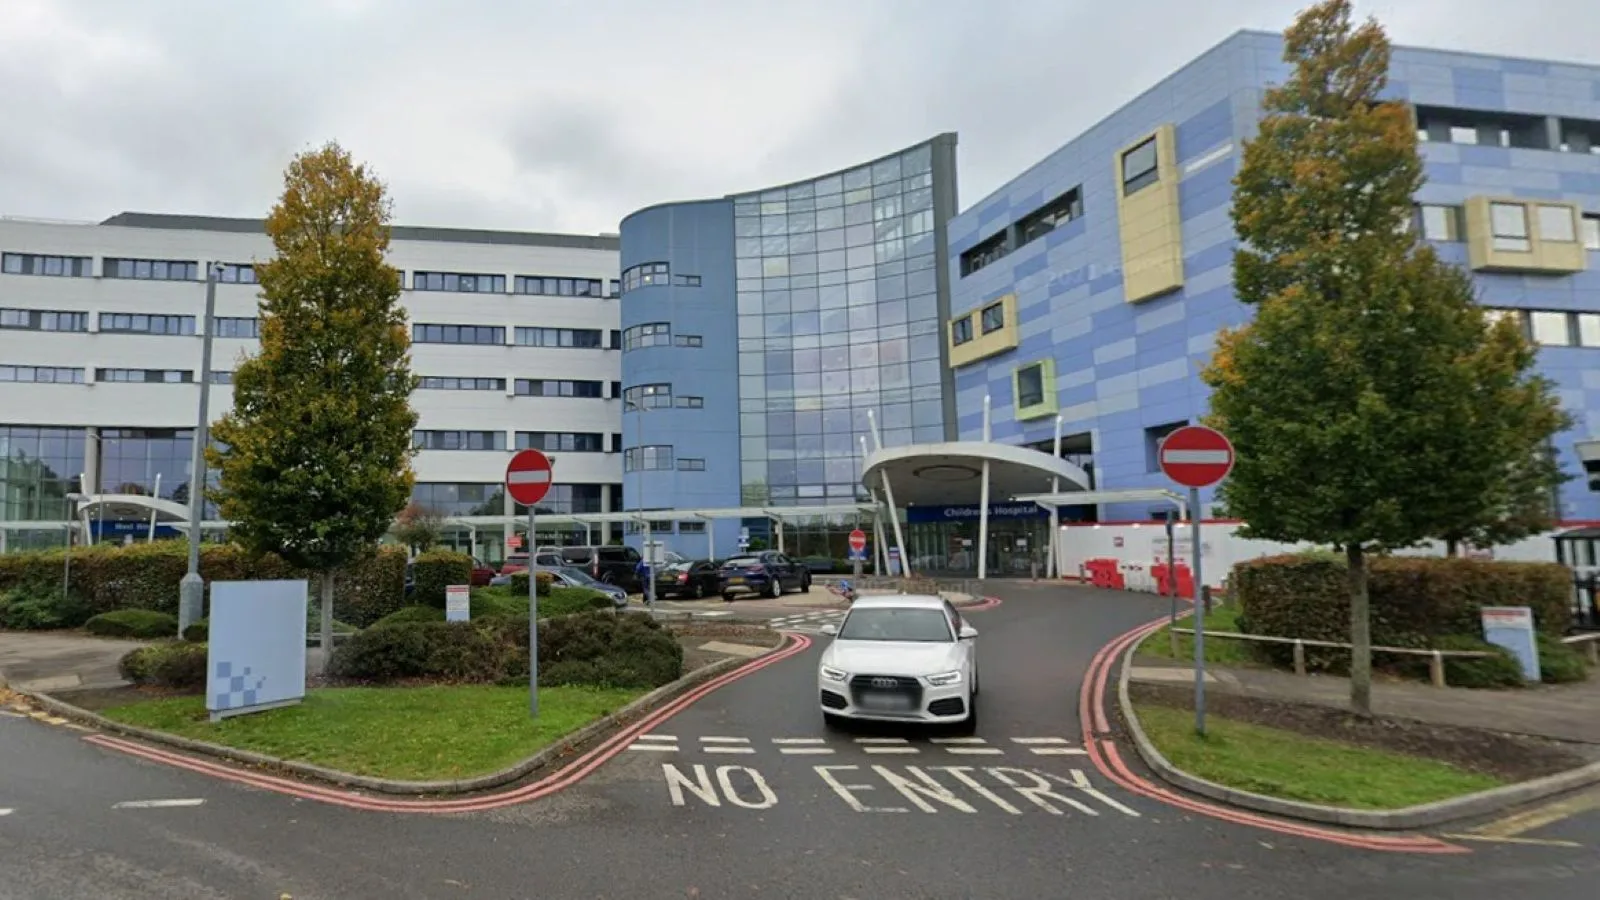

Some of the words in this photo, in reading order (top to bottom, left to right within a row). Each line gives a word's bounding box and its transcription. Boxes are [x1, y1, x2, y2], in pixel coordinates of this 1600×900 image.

[944, 507, 991, 517] Childres
[994, 504, 1038, 516] Hospital
[662, 763, 779, 809] NO
[812, 764, 1141, 817] ENTRY
